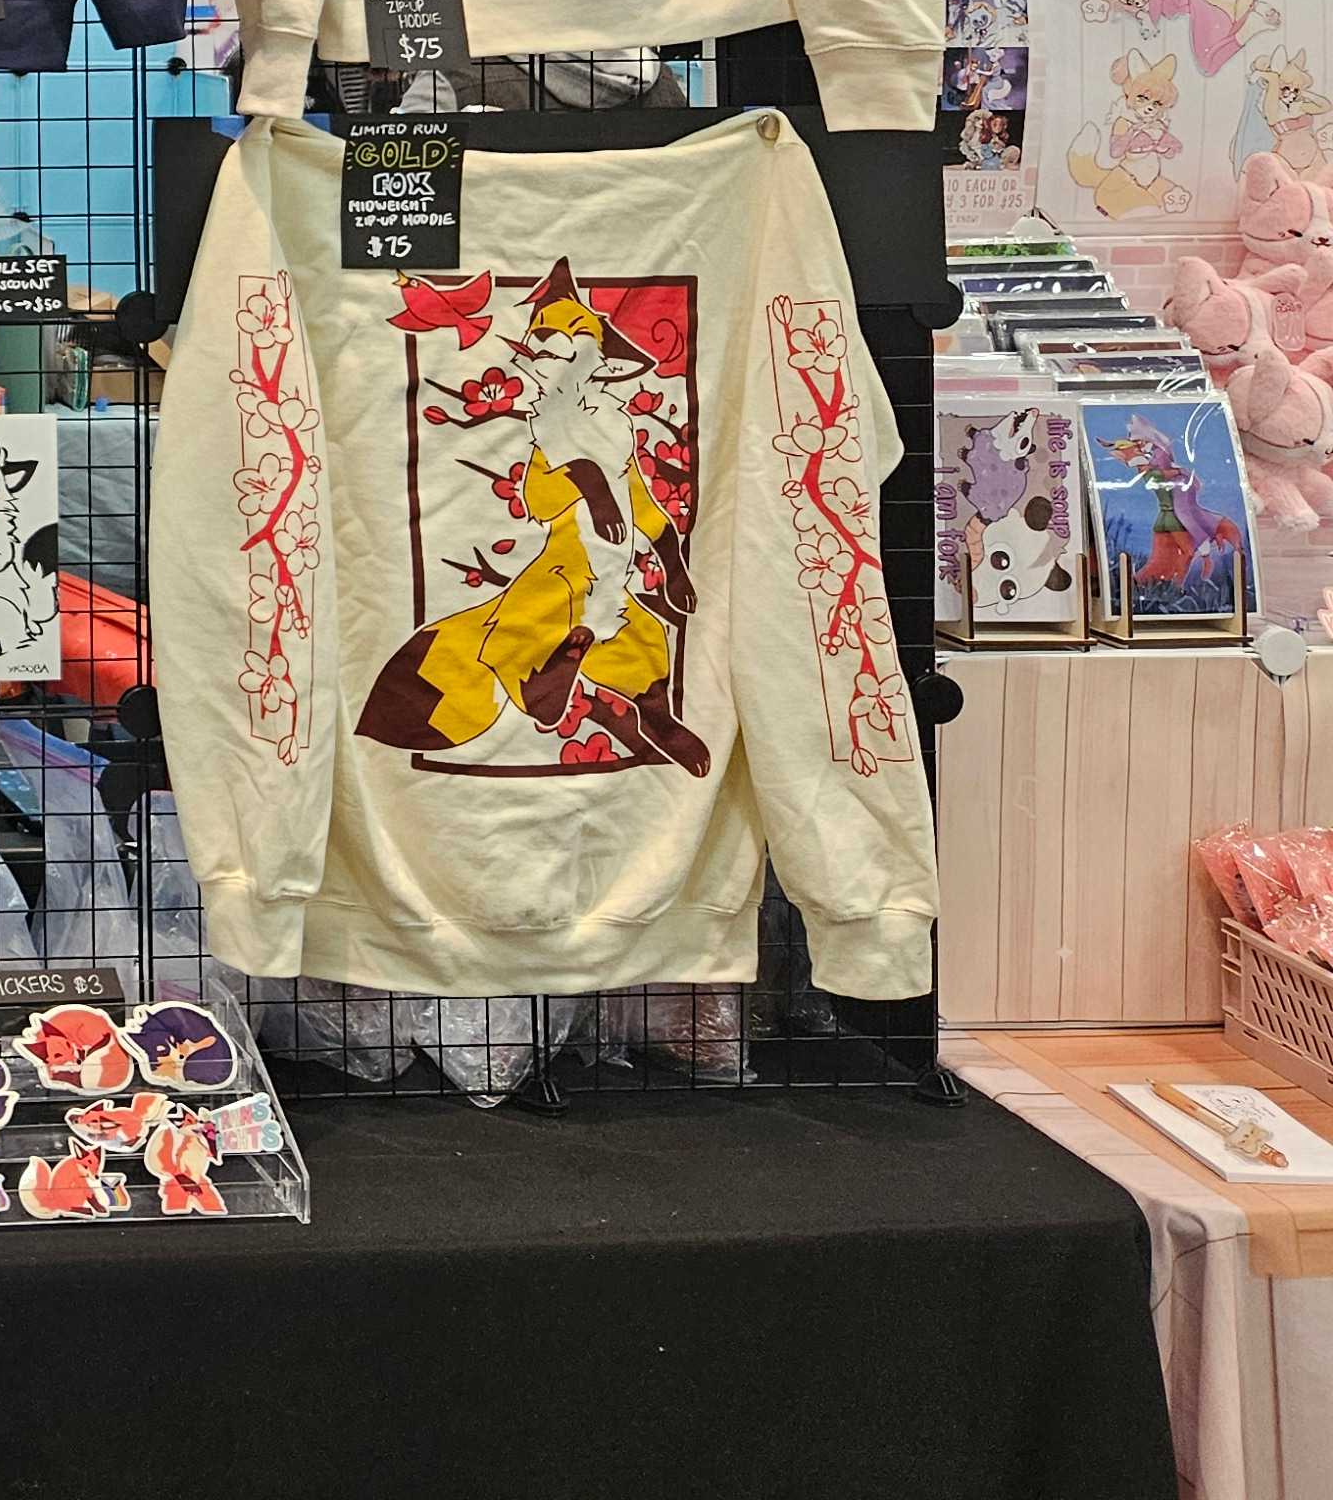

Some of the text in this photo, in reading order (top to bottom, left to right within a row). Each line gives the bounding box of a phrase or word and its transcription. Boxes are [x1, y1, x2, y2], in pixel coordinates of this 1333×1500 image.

[386, 0, 425, 14] ZIP-UP
[399, 13, 442, 28] HOODIE
[399, 35, 443, 62] $75
[350, 122, 448, 137] LIMITED RUN
[354, 141, 450, 169] GOLD
[373, 171, 436, 198] FOX
[965, 179, 997, 193] EACH
[348, 197, 433, 214] MIDWEIGHT
[959, 194, 968, 209] 3
[972, 194, 995, 209] FOR
[999, 193, 1023, 210] $25
[355, 212, 457, 229] ZIP-UP HOODIE
[367, 234, 413, 258] $75
[25, 260, 59, 274] SET
[1047, 417, 1073, 540] life is soup
[934, 482, 958, 521] am
[73, 974, 104, 995] $3
